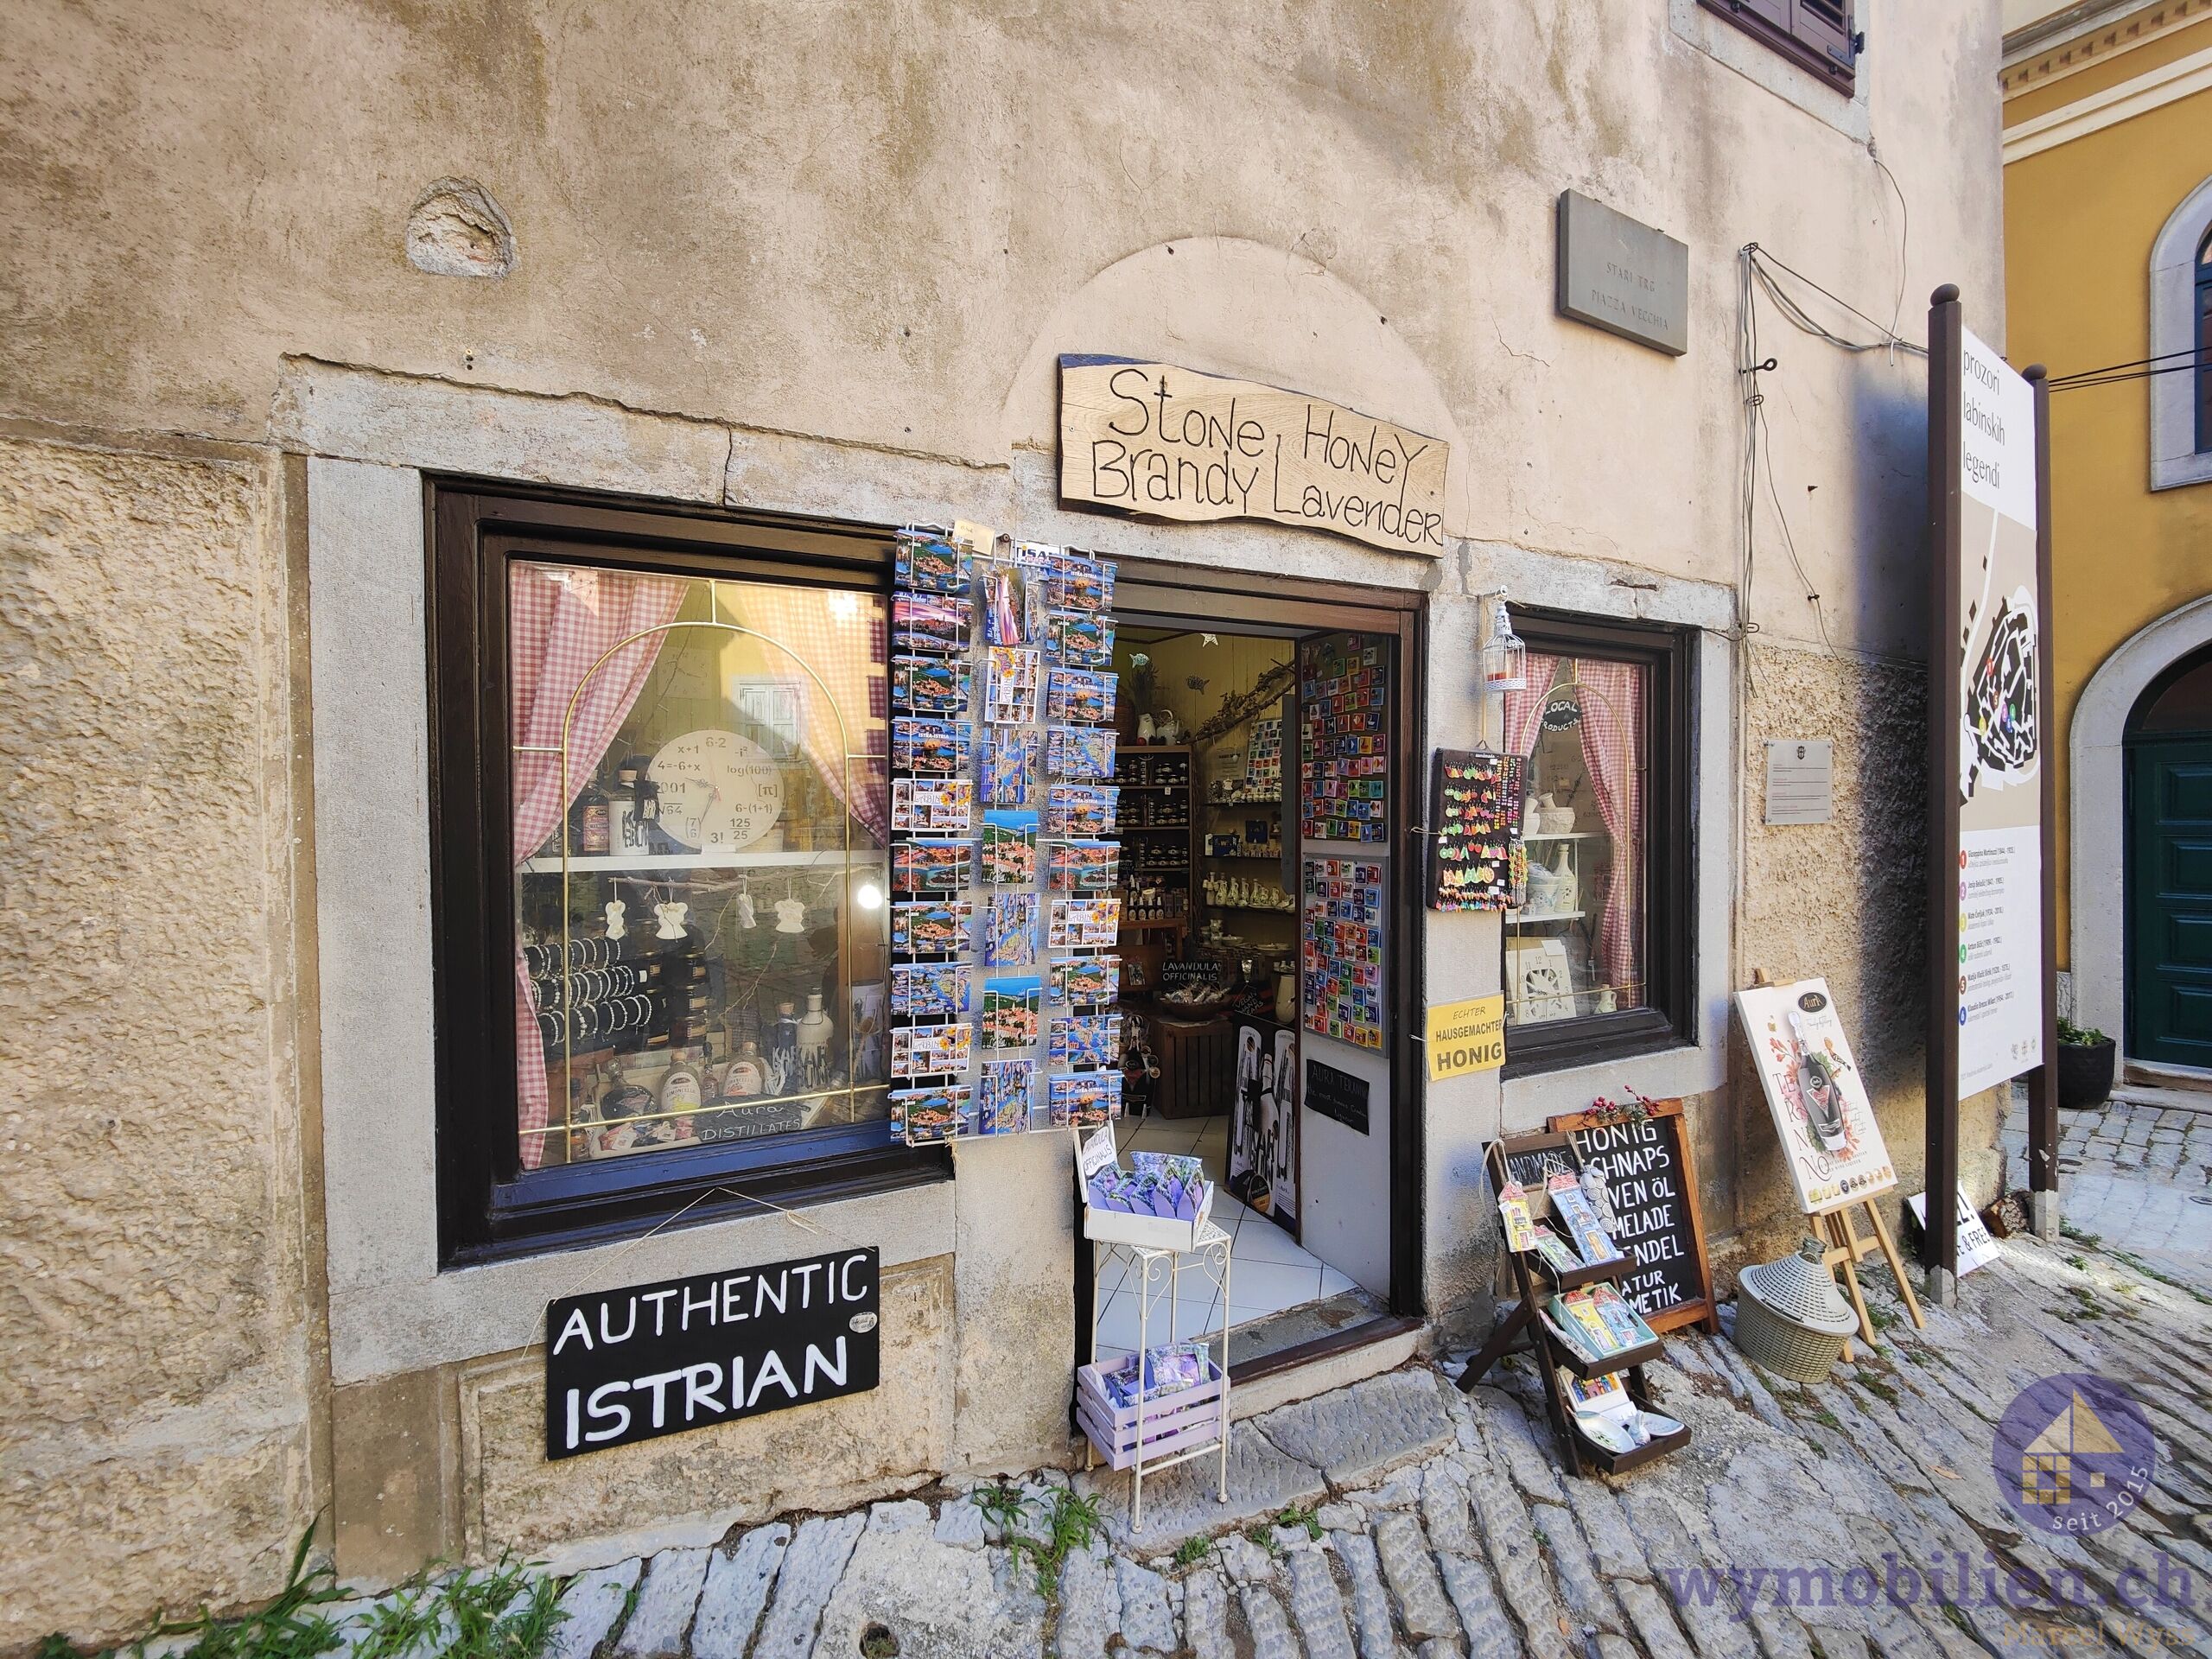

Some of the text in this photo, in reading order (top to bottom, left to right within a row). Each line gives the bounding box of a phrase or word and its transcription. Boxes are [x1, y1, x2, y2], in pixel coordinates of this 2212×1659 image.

[1606, 262, 1656, 292] STARI TRG
[1592, 289, 1669, 330] PIAZZA VECCHIA
[1963, 348, 1999, 396] prozori
[1963, 391, 2005, 446] labinskih
[1092, 439, 1259, 514] Brandy
[1963, 441, 2000, 489] legendi
[1162, 962, 1218, 971] LAVANDULA
[1163, 972, 1217, 982] OFFICINALIS
[1452, 1006, 1486, 1020] ECHTER
[1435, 1019, 1503, 1042] HAUSGEMACHTER
[1437, 1041, 1502, 1071] HONIG
[716, 1101, 784, 1118] Aura
[1581, 1145, 1669, 1179] CHNAPS
[1608, 1177, 1675, 1210] VEN ÖL
[1612, 1205, 1675, 1241] MELADE
[1622, 1269, 1665, 1296] ATUR
[1628, 1282, 1682, 1315] METIK
[552, 1255, 868, 1356] AUTHENTIC
[566, 1335, 848, 1450] ISTRIAN
